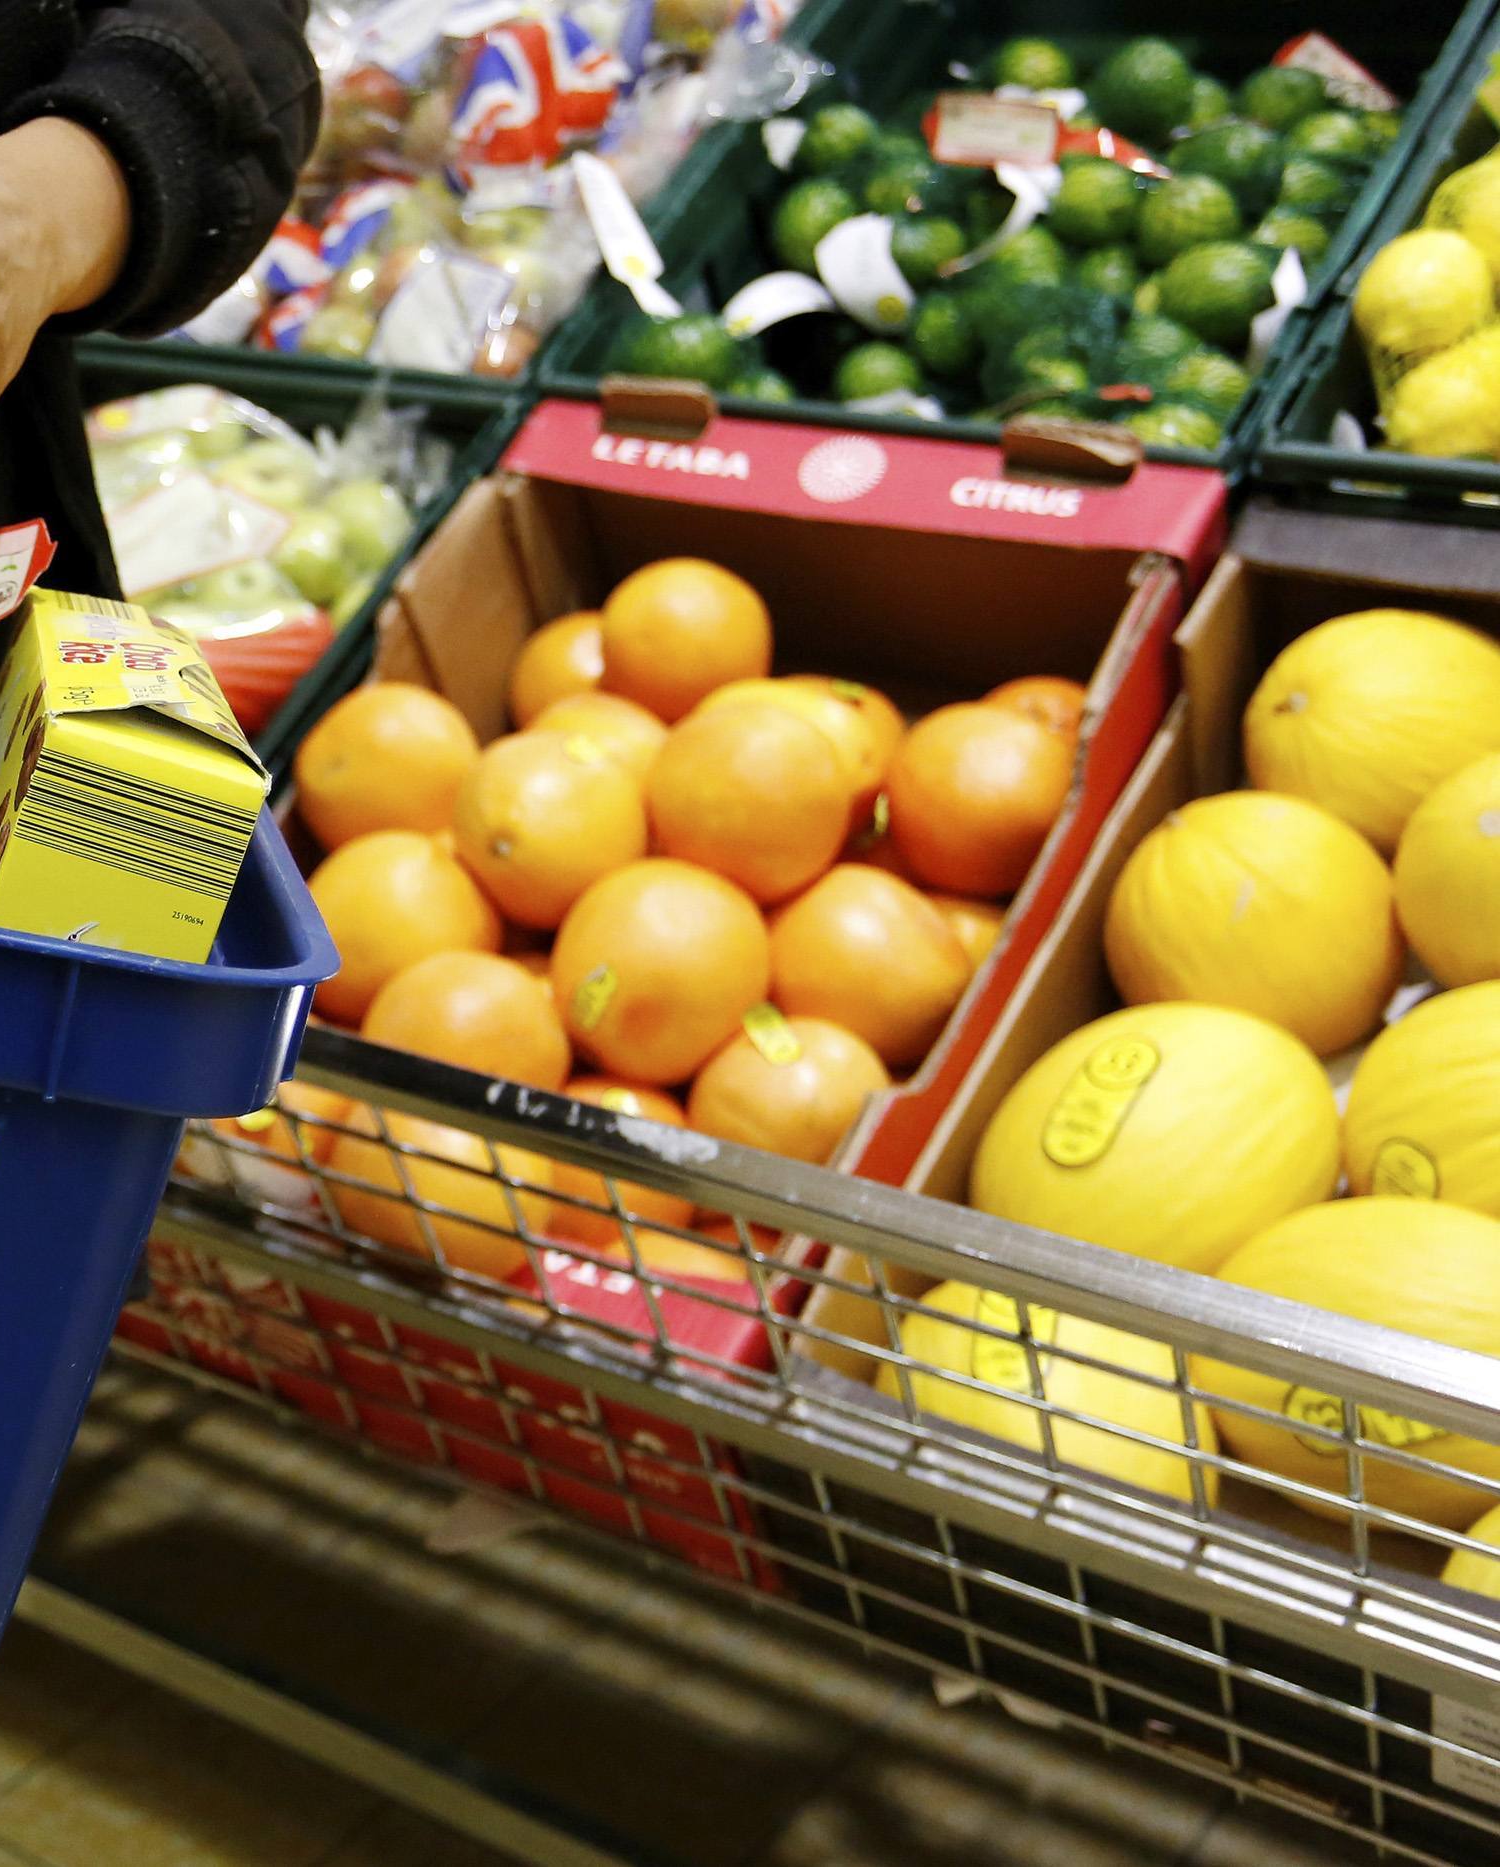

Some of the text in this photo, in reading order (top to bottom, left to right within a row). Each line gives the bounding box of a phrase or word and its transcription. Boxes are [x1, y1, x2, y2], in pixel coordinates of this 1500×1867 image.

[592, 434, 1083, 518] LETABA CITRUS
[58, 641, 116, 663] Rice
[120, 643, 177, 670] Choco
[172, 911, 205, 926] 25190694
